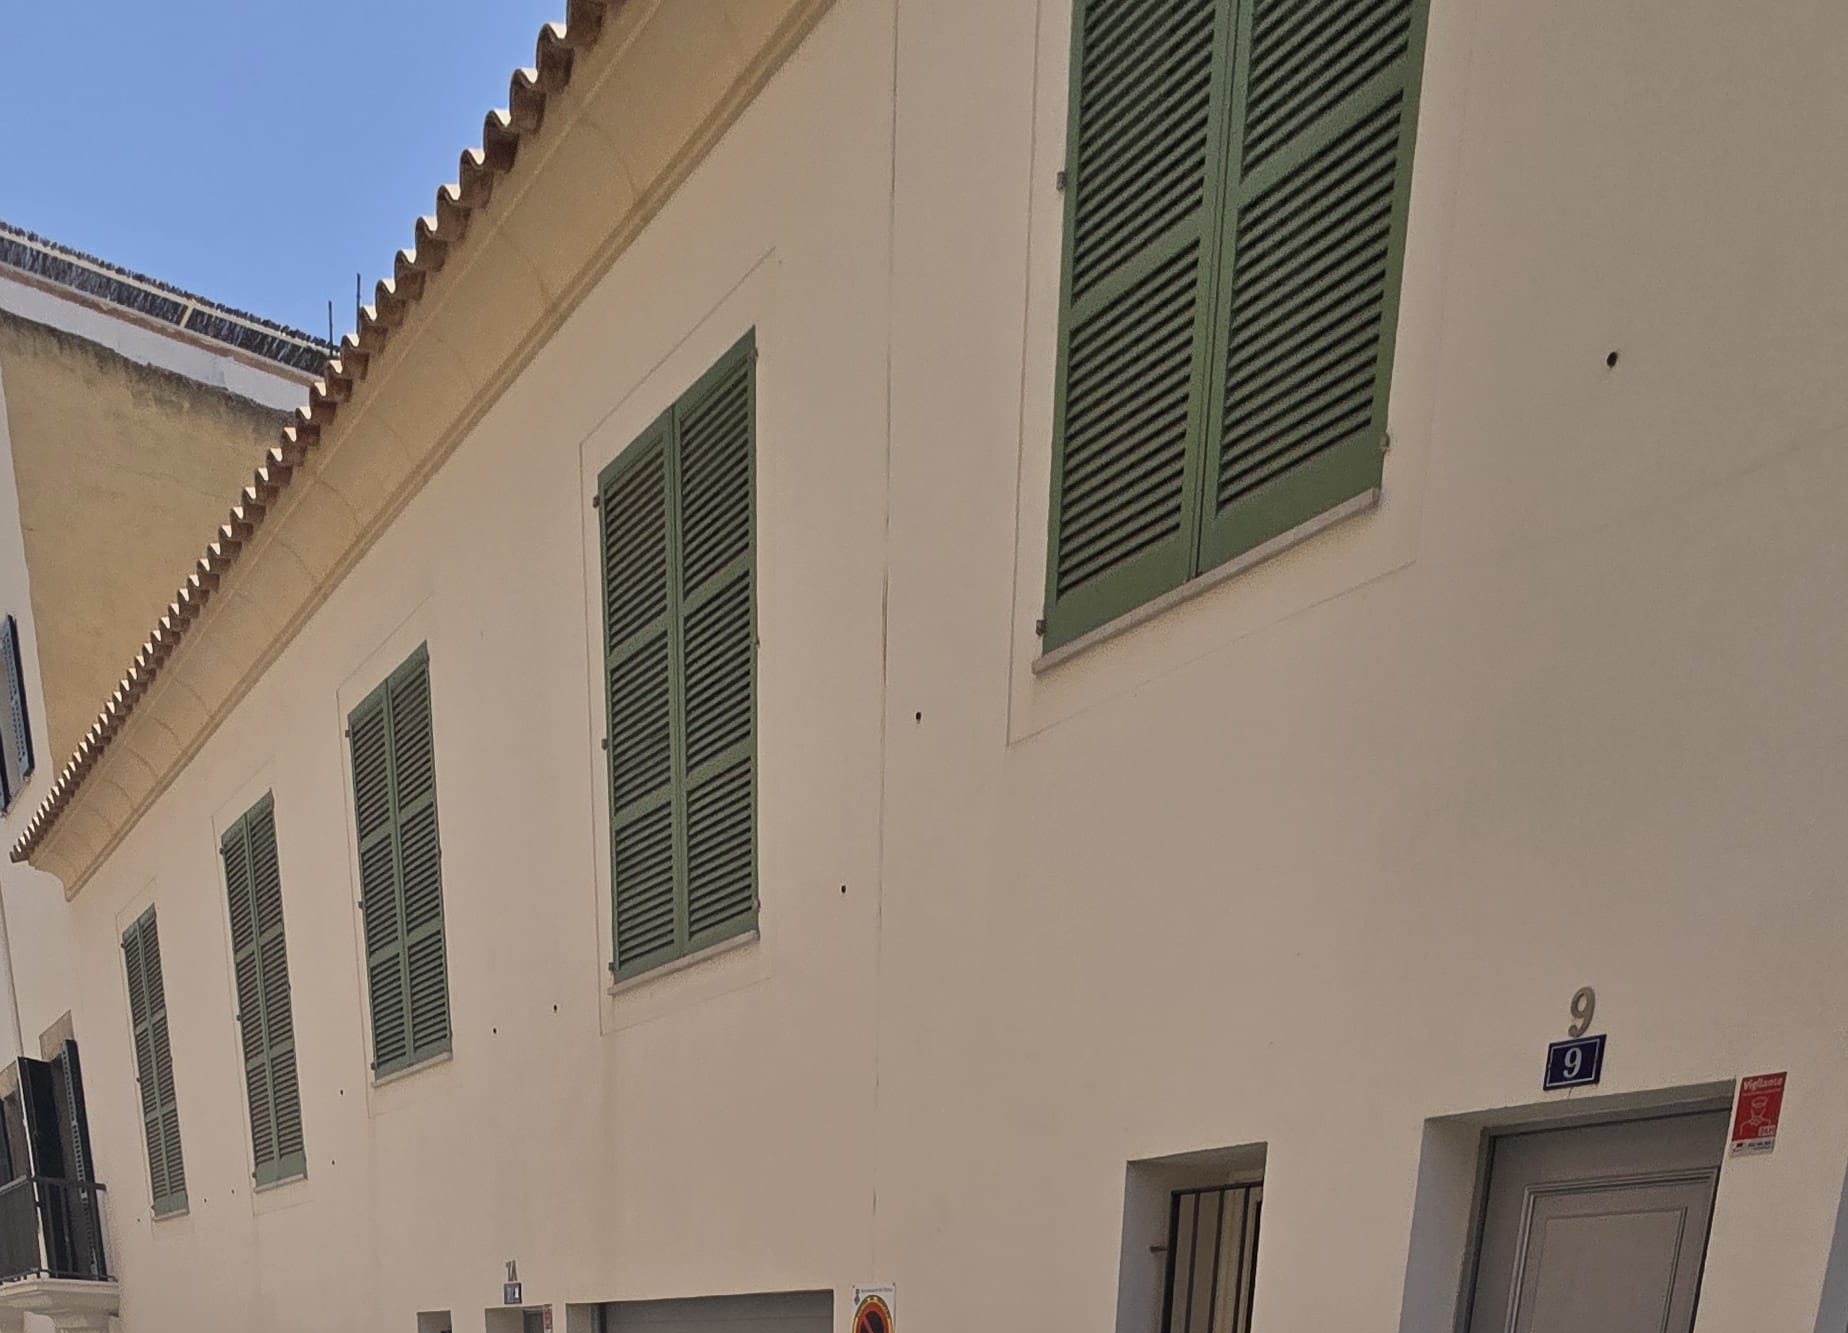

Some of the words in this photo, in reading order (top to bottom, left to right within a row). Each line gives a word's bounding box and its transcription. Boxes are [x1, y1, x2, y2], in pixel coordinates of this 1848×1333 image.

[1568, 986, 1595, 1038] 9
[1563, 1047, 1582, 1078] 9
[1743, 1077, 1784, 1091] Vigilante
[505, 1259, 518, 1282] 1A
